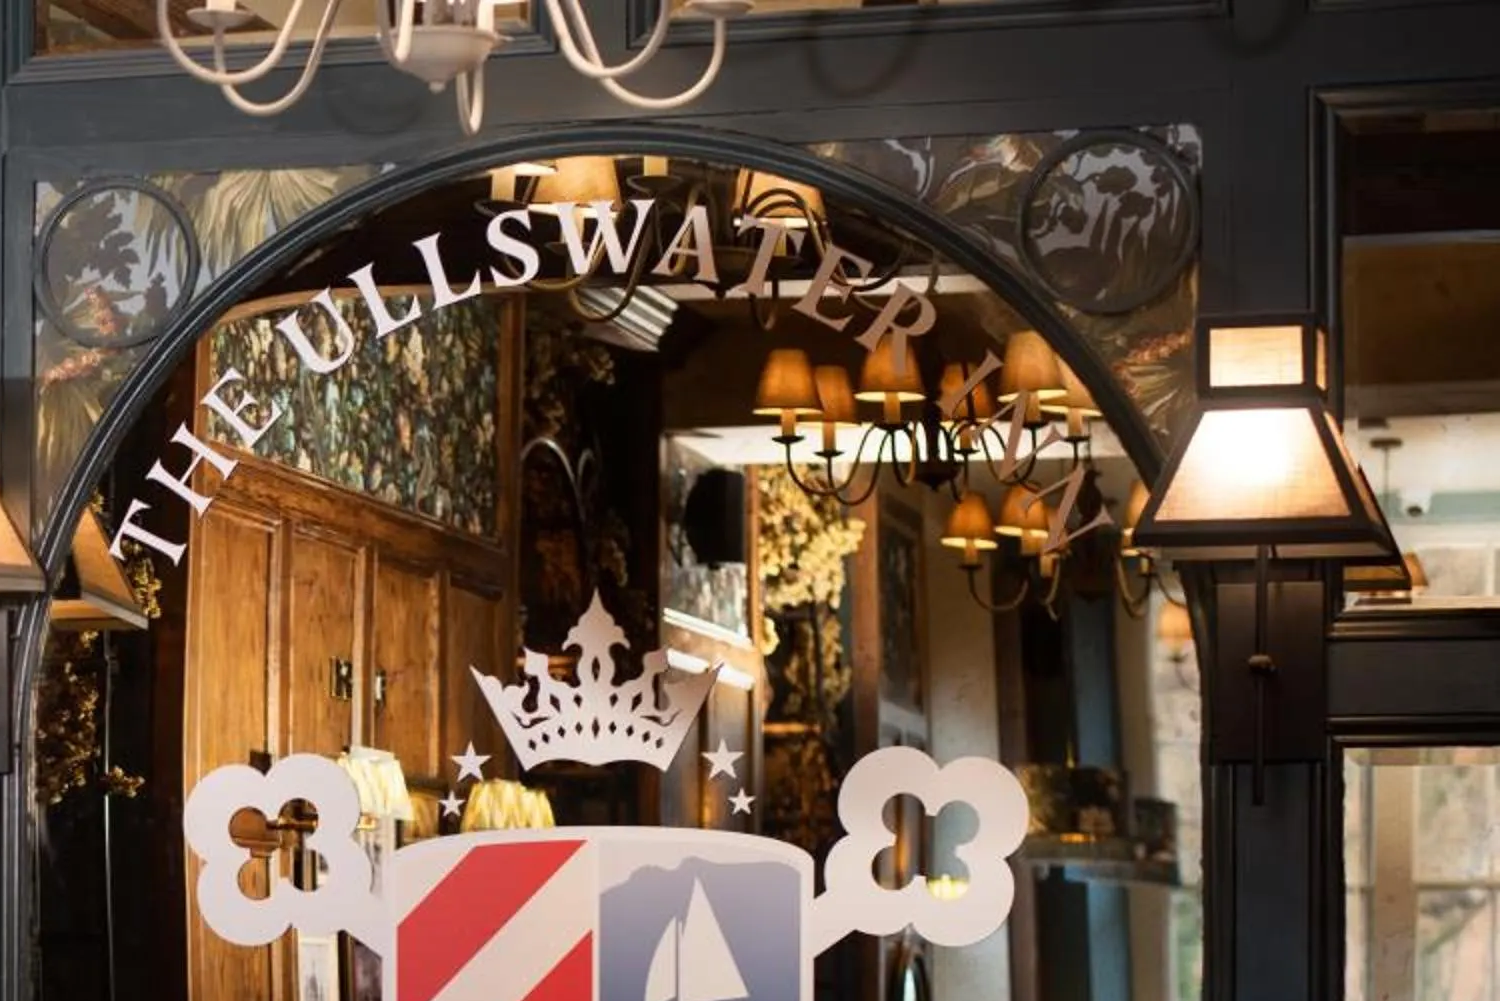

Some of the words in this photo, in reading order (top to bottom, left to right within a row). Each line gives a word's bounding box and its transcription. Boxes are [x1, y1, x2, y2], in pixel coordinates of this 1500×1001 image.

[108, 366, 283, 567] THE
[275, 199, 938, 376] ULLSWATER
[936, 350, 1115, 551] INN
